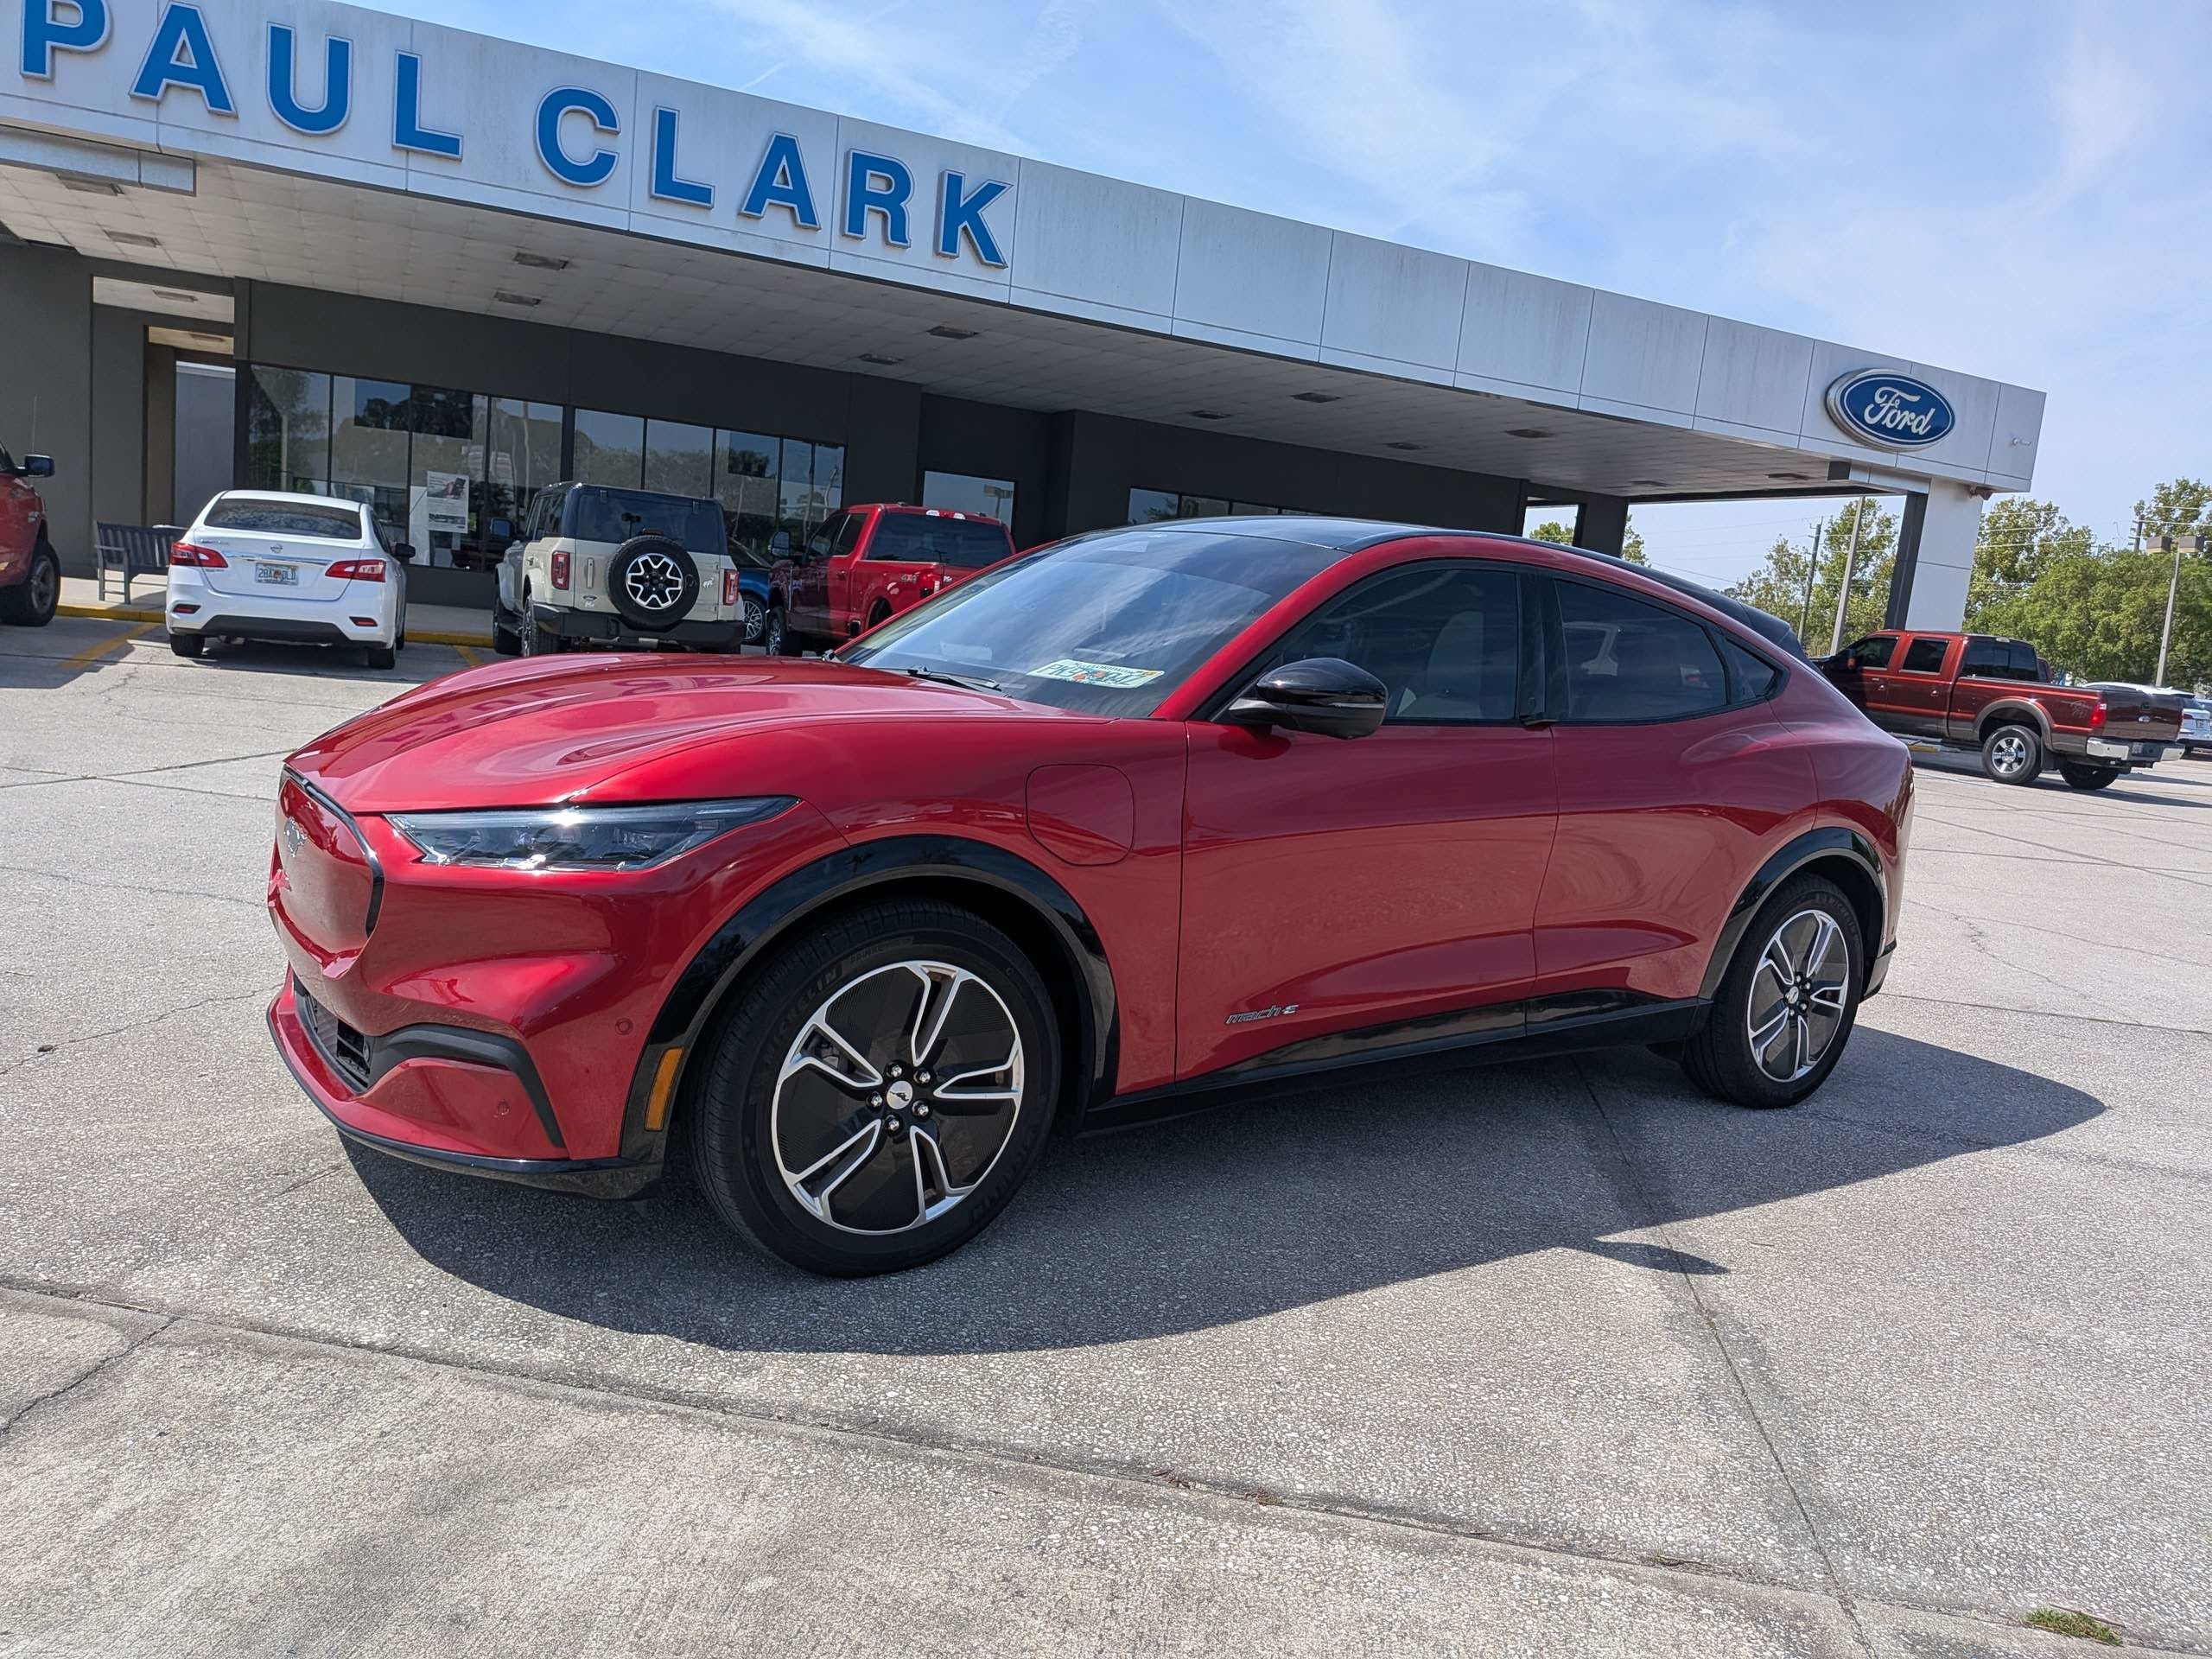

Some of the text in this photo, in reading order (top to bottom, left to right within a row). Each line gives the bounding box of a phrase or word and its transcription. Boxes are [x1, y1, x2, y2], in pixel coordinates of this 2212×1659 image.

[19, 0, 1014, 269] PAUL CLARK
[1864, 386, 1936, 435] Ford
